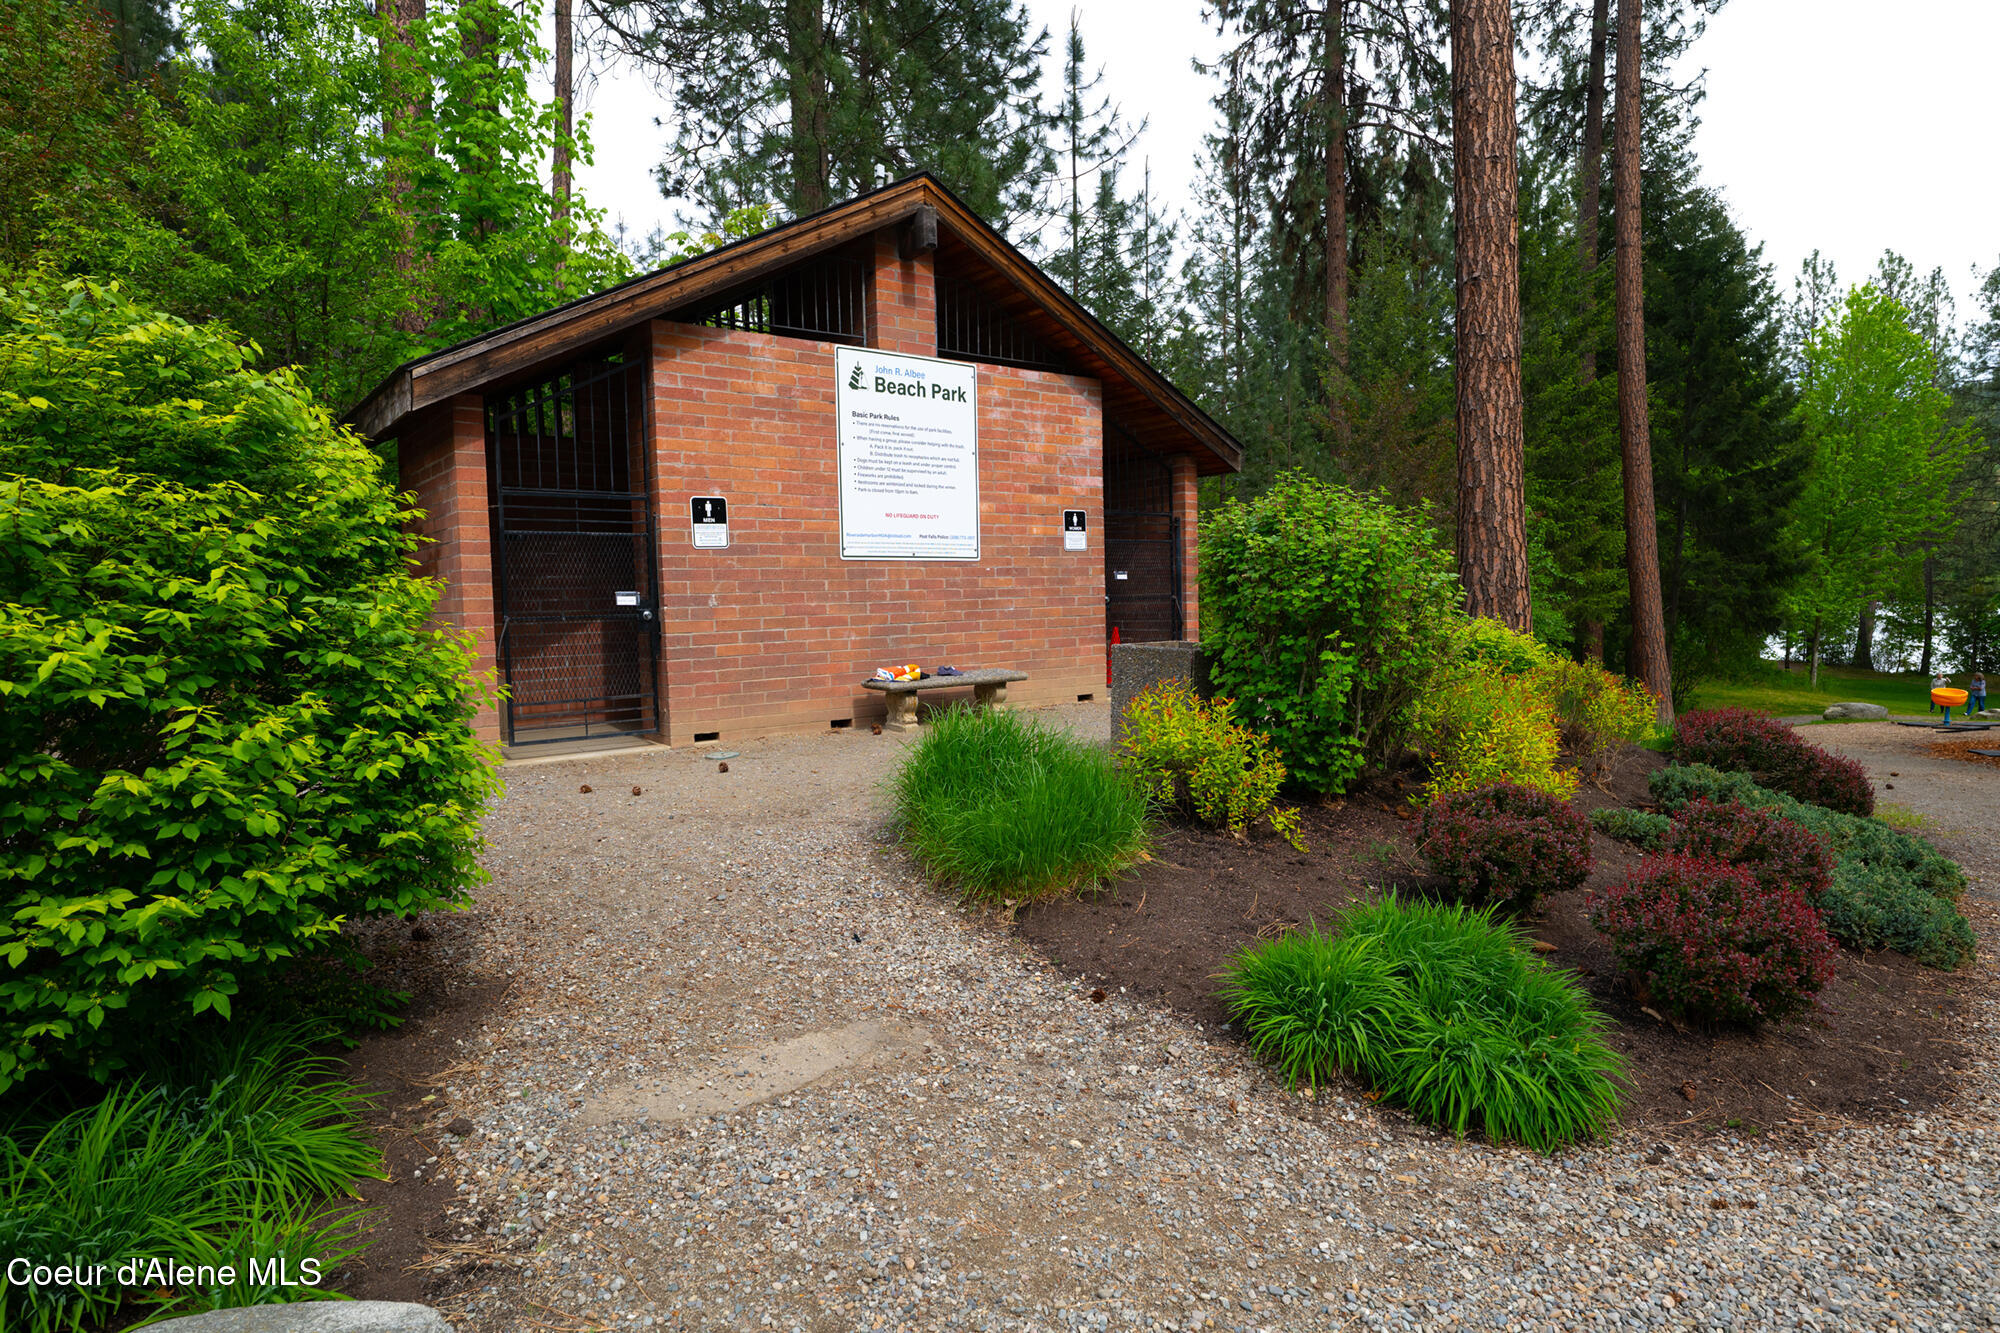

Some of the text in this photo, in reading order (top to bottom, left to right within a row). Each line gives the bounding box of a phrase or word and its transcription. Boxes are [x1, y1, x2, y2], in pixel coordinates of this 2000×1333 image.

[875, 365, 926, 379] John R. Albee
[875, 376, 967, 403] Beach Park
[852, 410, 868, 418] Basic
[869, 412, 883, 420] Park
